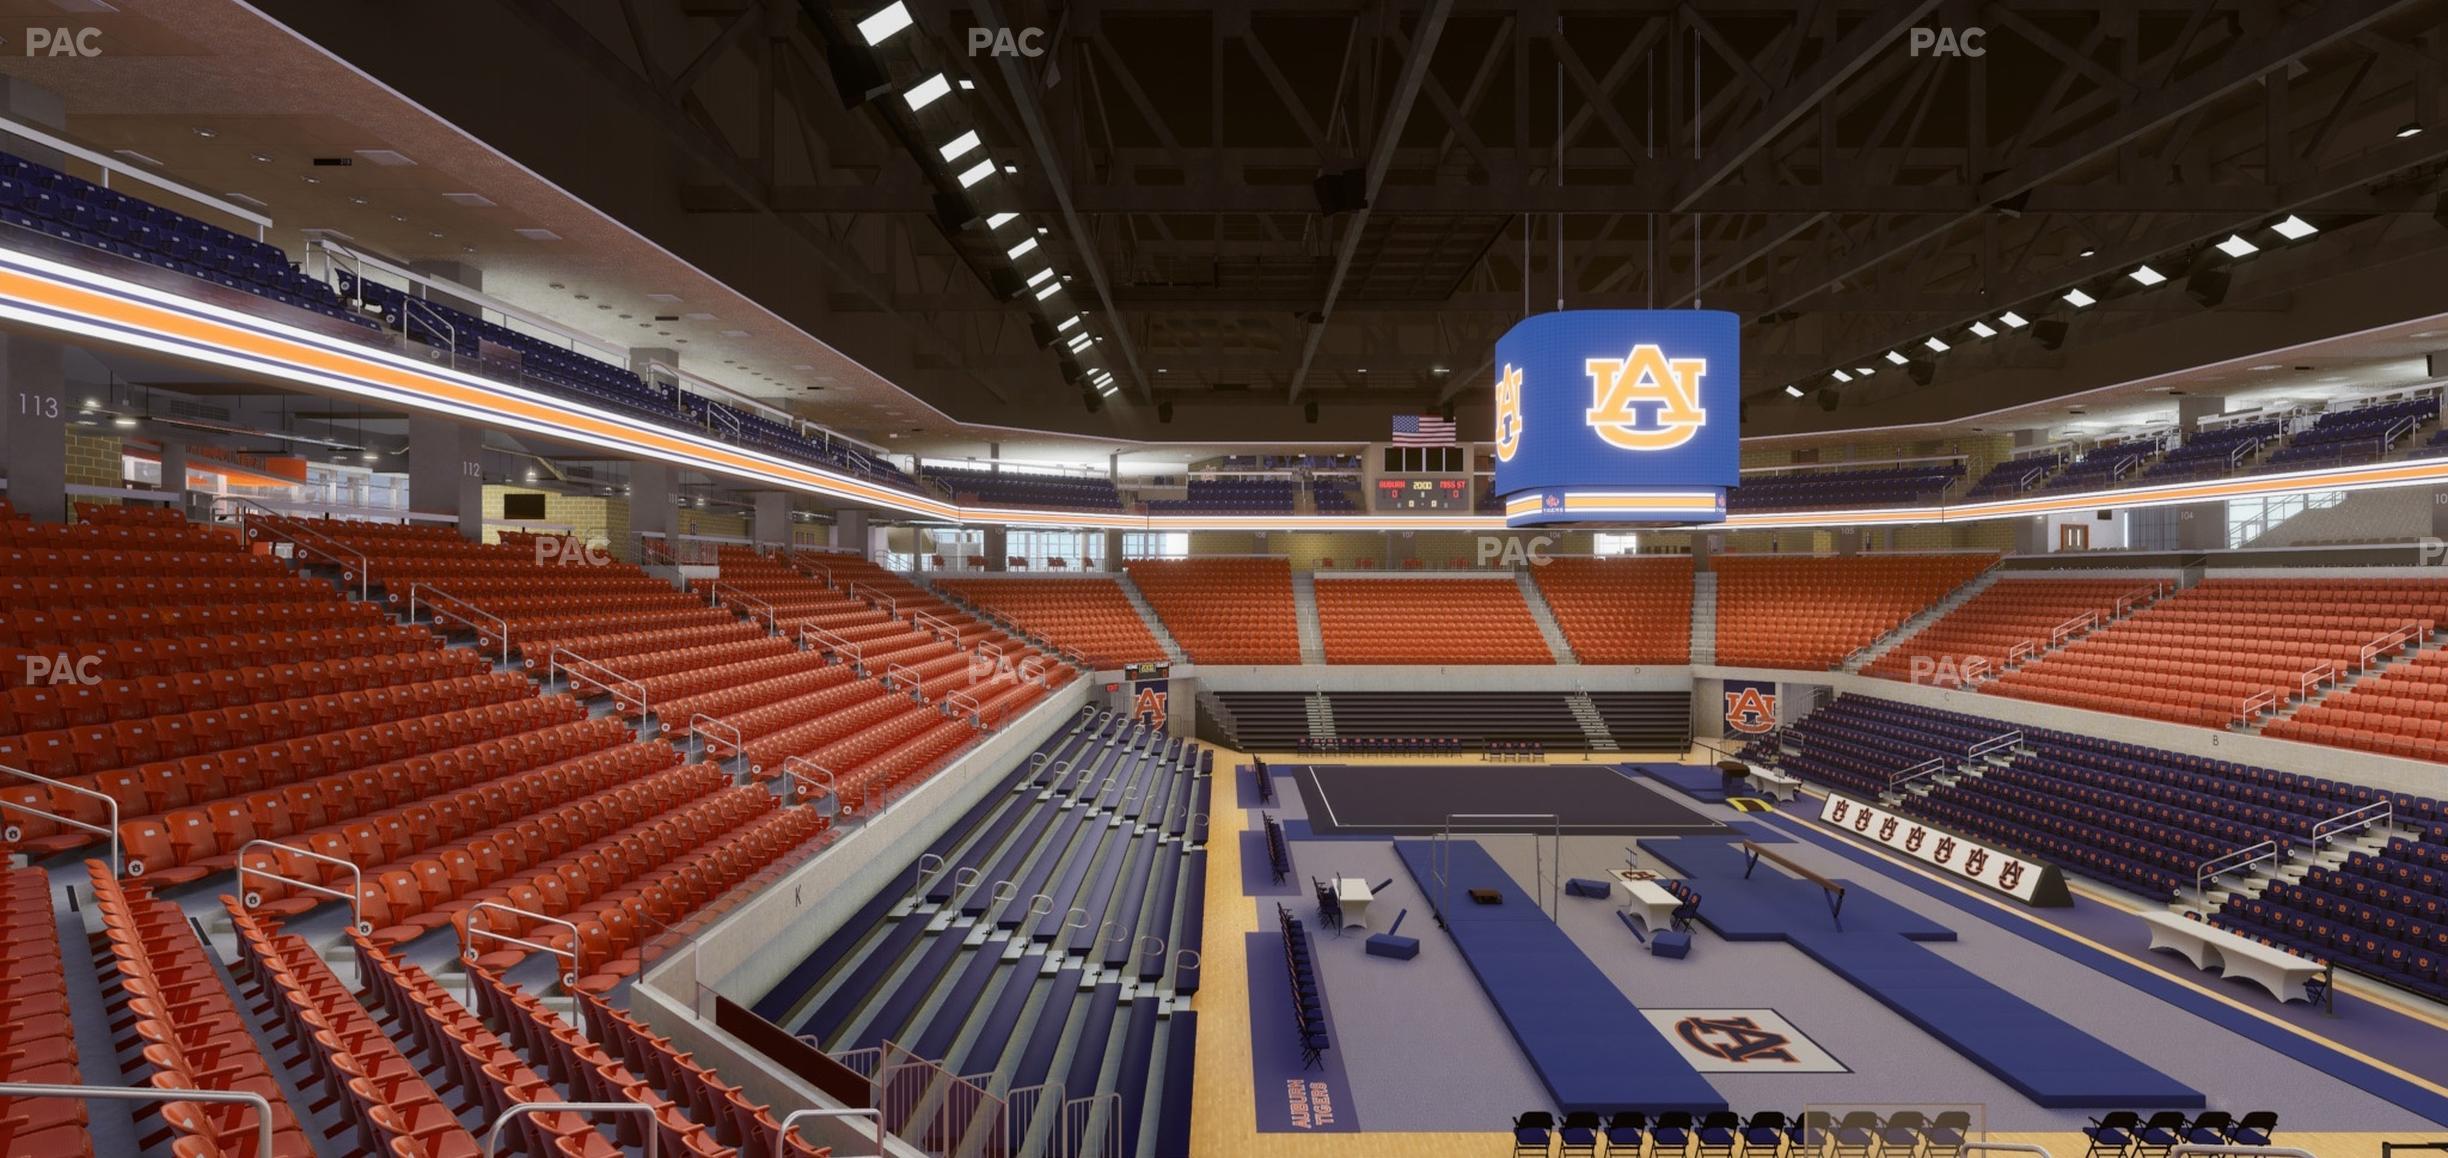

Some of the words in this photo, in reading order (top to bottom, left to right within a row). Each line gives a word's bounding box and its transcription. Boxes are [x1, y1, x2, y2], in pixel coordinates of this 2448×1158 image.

[20, 393, 58, 418] 113
[463, 461, 480, 477] 112
[2435, 493, 2448, 504] 10
[2181, 511, 2194, 521] 104
[795, 884, 802, 907] K
[1287, 1080, 1312, 1129] AUBURN
[1309, 1082, 1335, 1126] TIGERS
